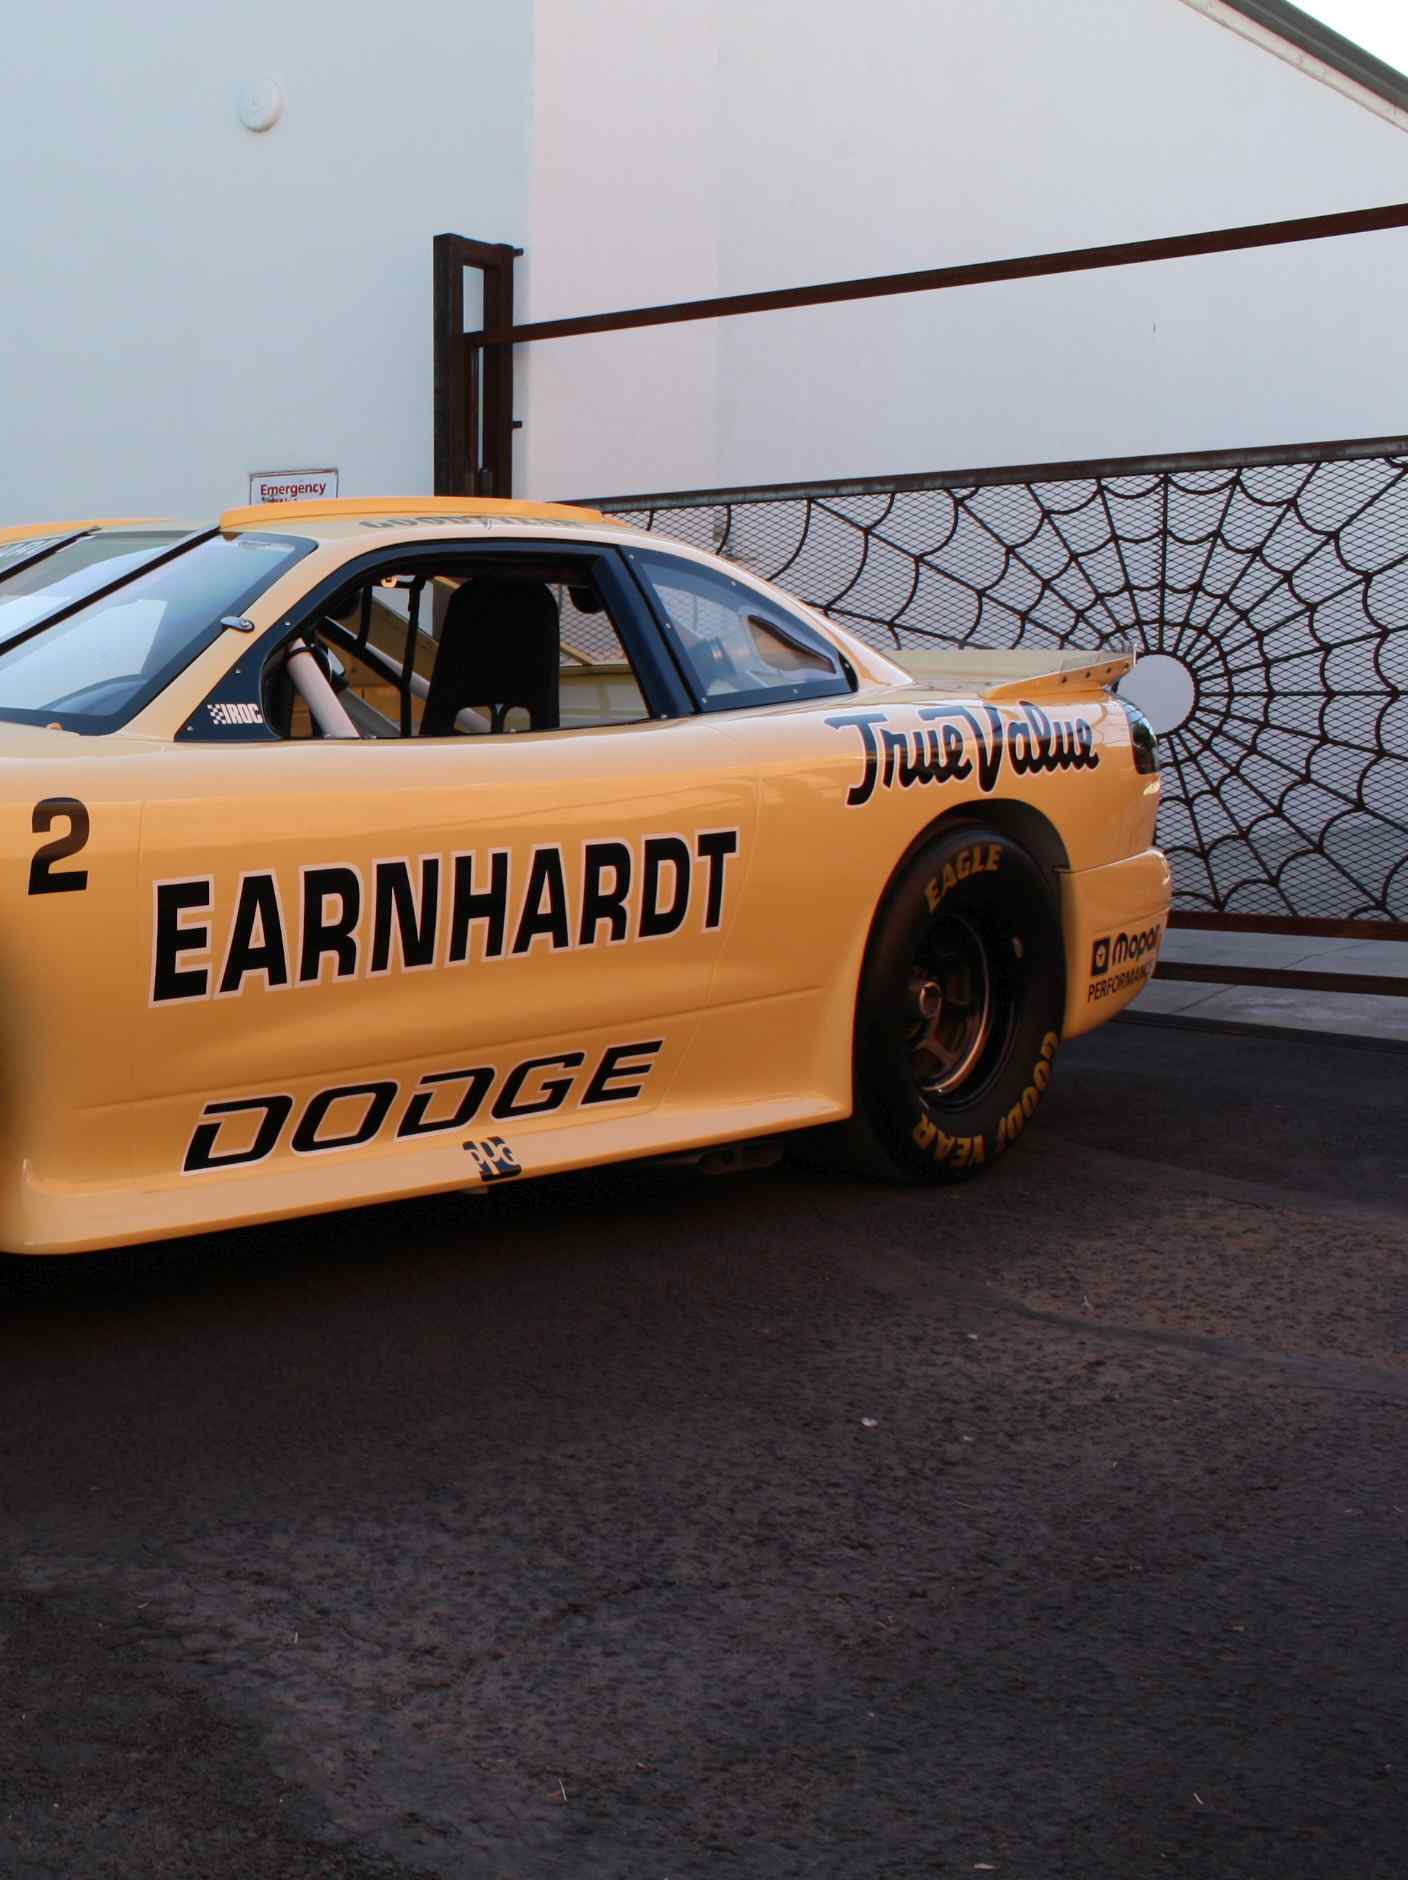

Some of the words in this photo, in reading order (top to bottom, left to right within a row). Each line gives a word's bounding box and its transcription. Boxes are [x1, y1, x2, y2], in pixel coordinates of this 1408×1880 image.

[259, 482, 326, 498] Emergency
[220, 703, 264, 724] IROC
[28, 796, 90, 896] 2
[926, 844, 1003, 913] EAGLE
[150, 828, 740, 1006] EARNHARDT
[1087, 961, 1154, 1004] PERFORMAN
[182, 1039, 663, 1173] DODGE
[463, 1136, 522, 1182] PPG
